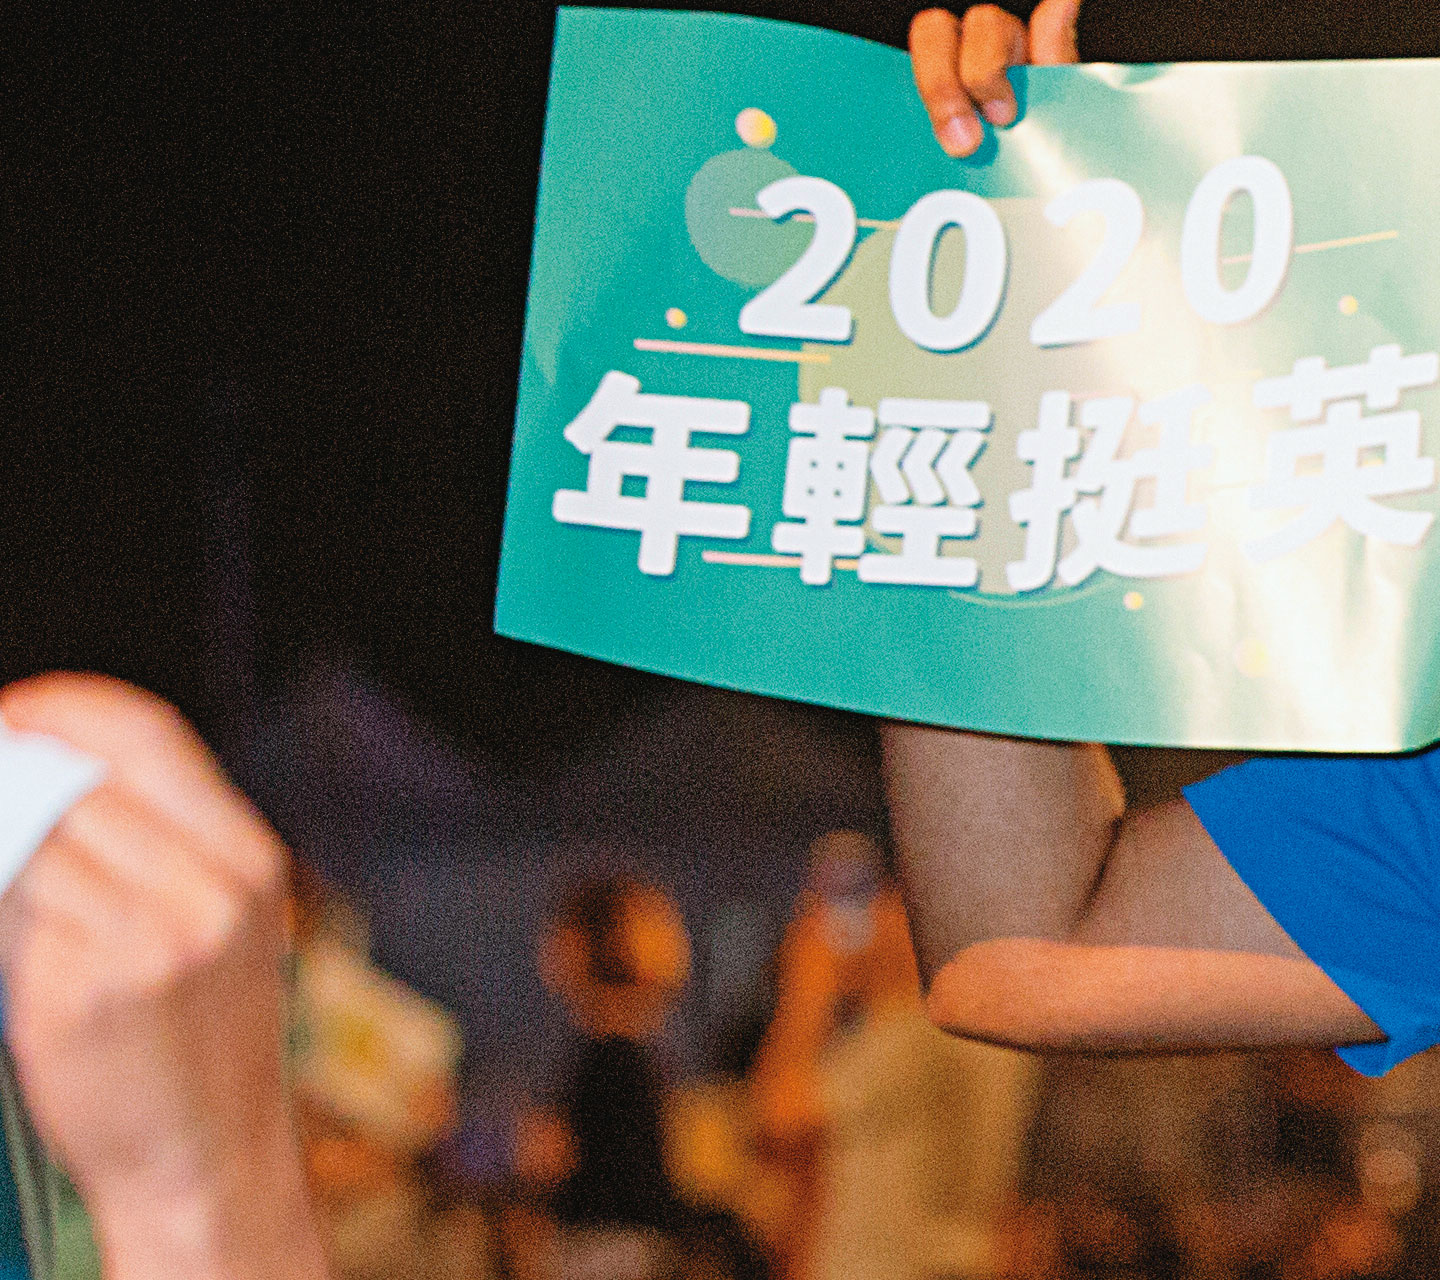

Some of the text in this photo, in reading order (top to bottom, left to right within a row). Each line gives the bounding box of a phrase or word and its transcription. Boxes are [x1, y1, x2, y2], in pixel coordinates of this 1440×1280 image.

[738, 154, 1295, 354] 2020
[551, 342, 1440, 594] 年輕挺英
